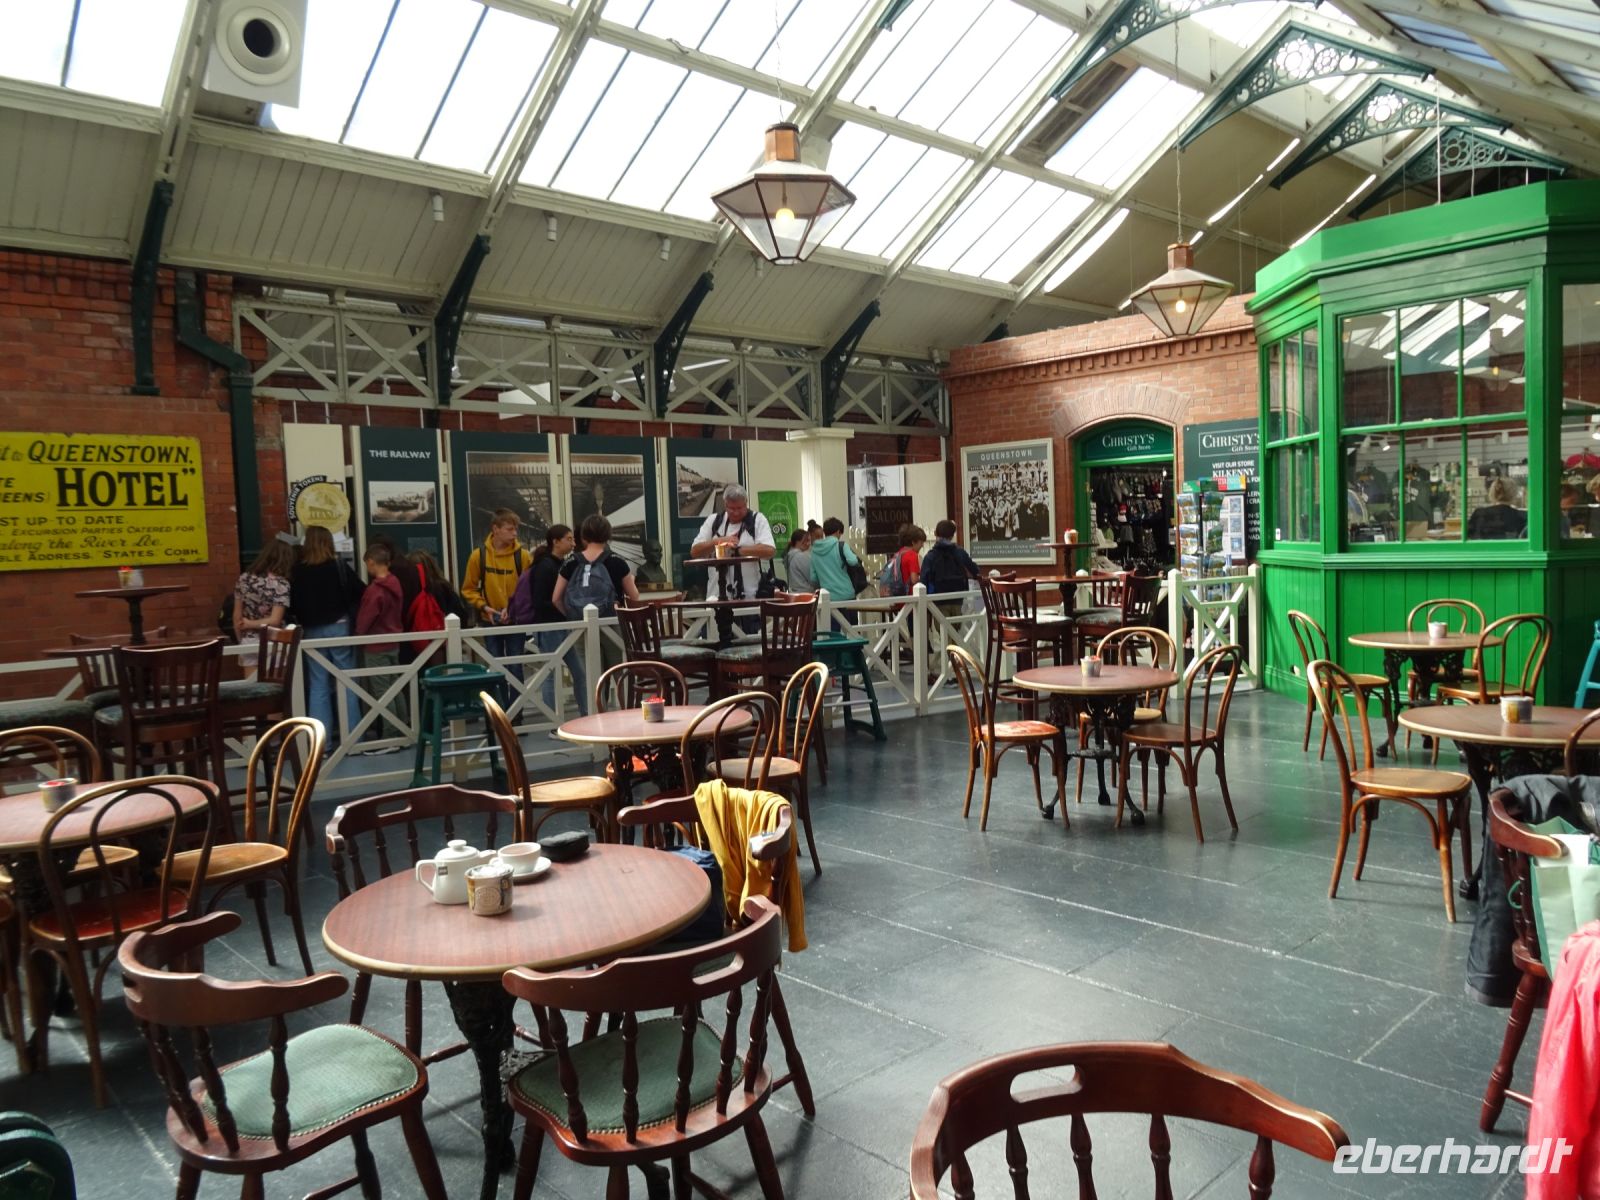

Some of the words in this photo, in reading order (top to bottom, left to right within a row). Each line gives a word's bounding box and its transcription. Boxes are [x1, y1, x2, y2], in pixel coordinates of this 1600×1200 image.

[1231, 444, 1244, 453] Gift
[369, 450, 388, 458] THE
[390, 450, 431, 459] RAILWAY
[980, 449, 1033, 461] QUEENSTOWN
[1212, 467, 1255, 478] KILKENNY
[299, 475, 324, 489] TOKENS
[0, 492, 45, 503] EENS
[871, 509, 909, 522] SALOON
